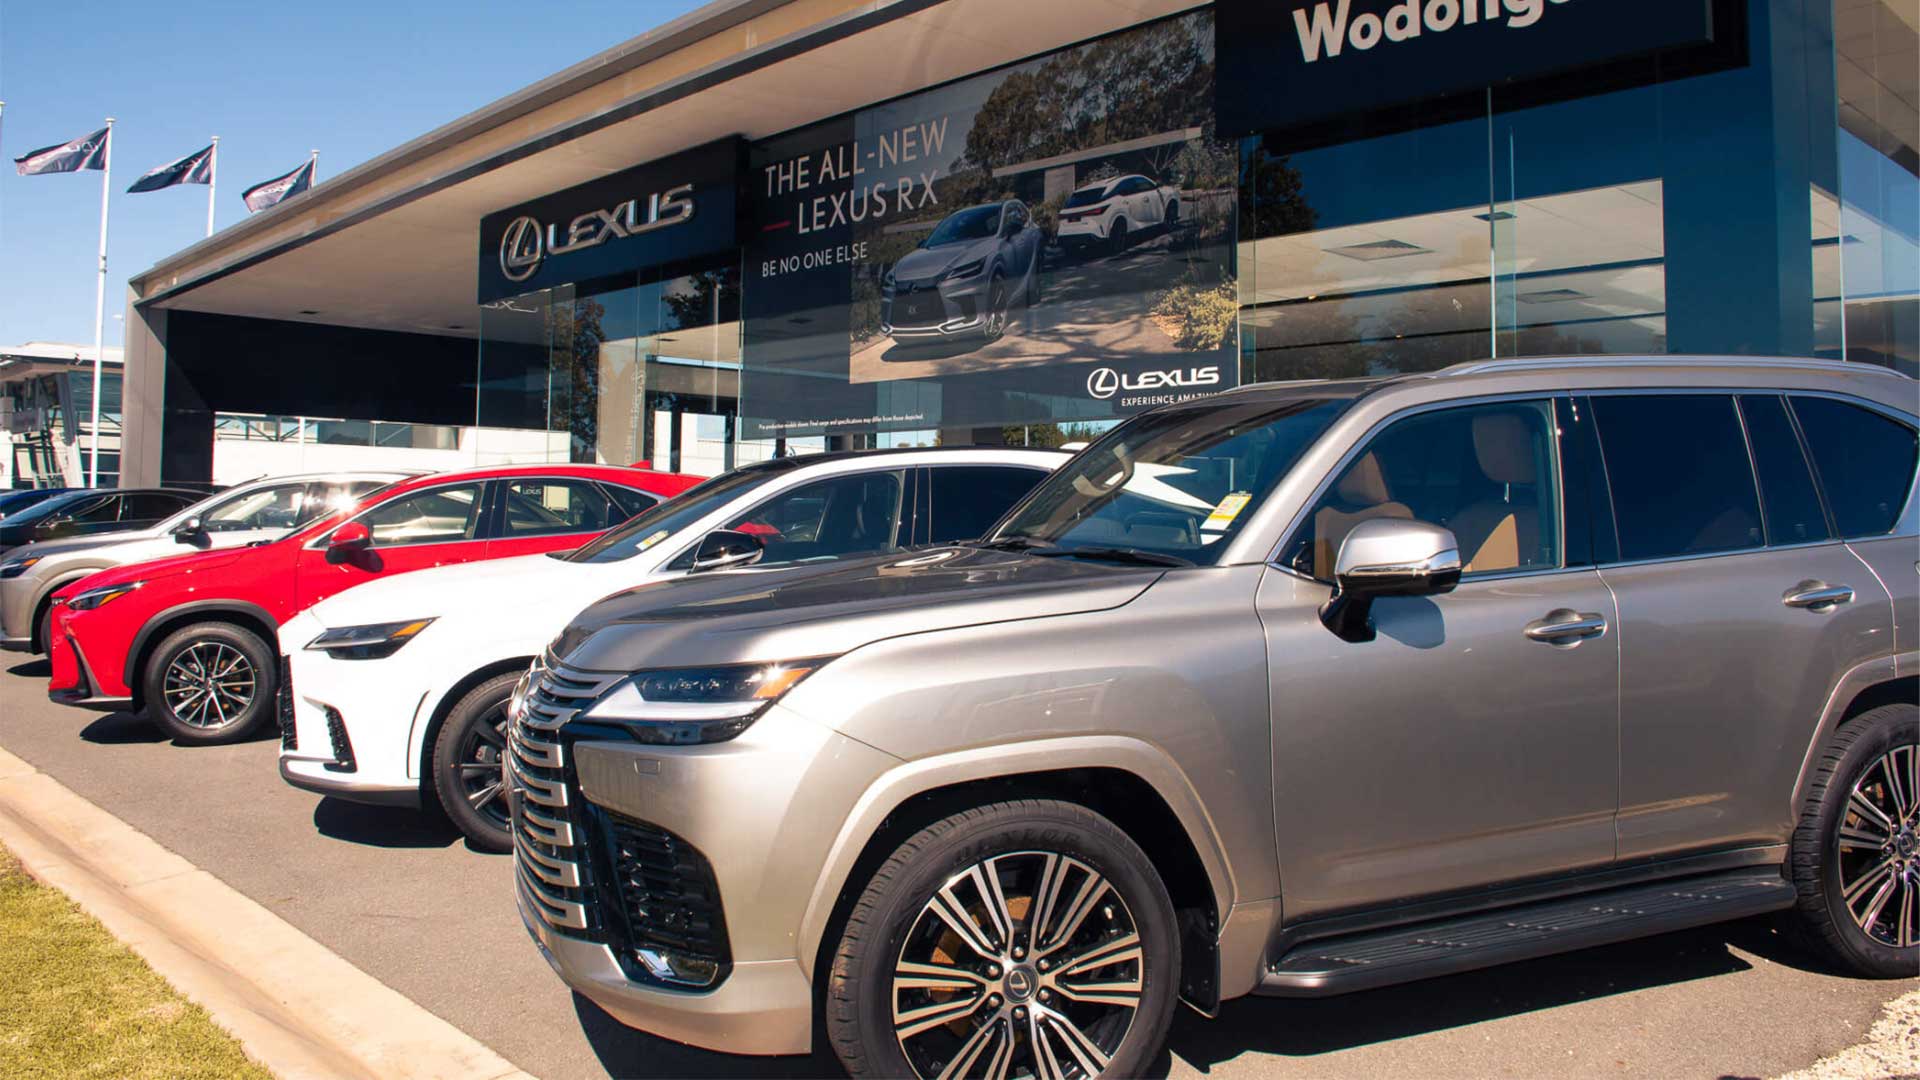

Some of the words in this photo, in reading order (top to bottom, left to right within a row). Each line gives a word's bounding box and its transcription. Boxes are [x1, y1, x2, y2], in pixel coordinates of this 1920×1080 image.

[1293, 0, 1568, 63] Wodong
[765, 155, 810, 198] THE
[818, 117, 948, 184] ALL-NEW
[547, 183, 695, 255] LEXUS
[798, 183, 887, 234] LEXUS
[898, 170, 938, 213] RX
[762, 259, 776, 278] BE
[780, 255, 799, 274] NO
[803, 249, 832, 269] ONE
[836, 241, 868, 263] ELSE
[1122, 366, 1220, 390] LEXUS
[1122, 395, 1175, 406] EXPERIENCE
